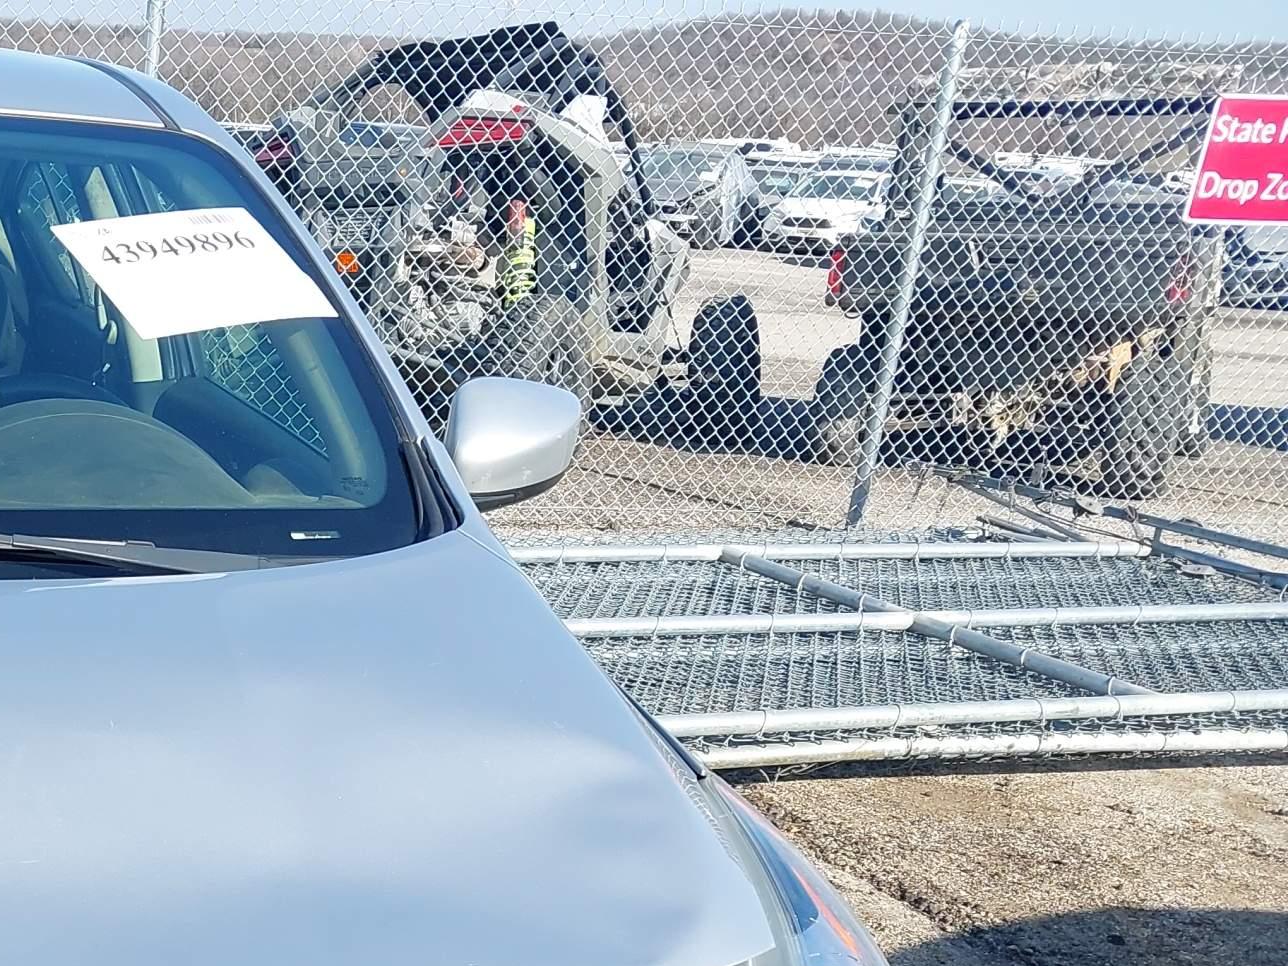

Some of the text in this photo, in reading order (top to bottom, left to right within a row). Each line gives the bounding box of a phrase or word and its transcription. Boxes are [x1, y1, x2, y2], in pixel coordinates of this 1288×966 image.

[1212, 114, 1277, 144] State
[1197, 171, 1259, 205] Drop
[102, 230, 255, 264] 43949896
